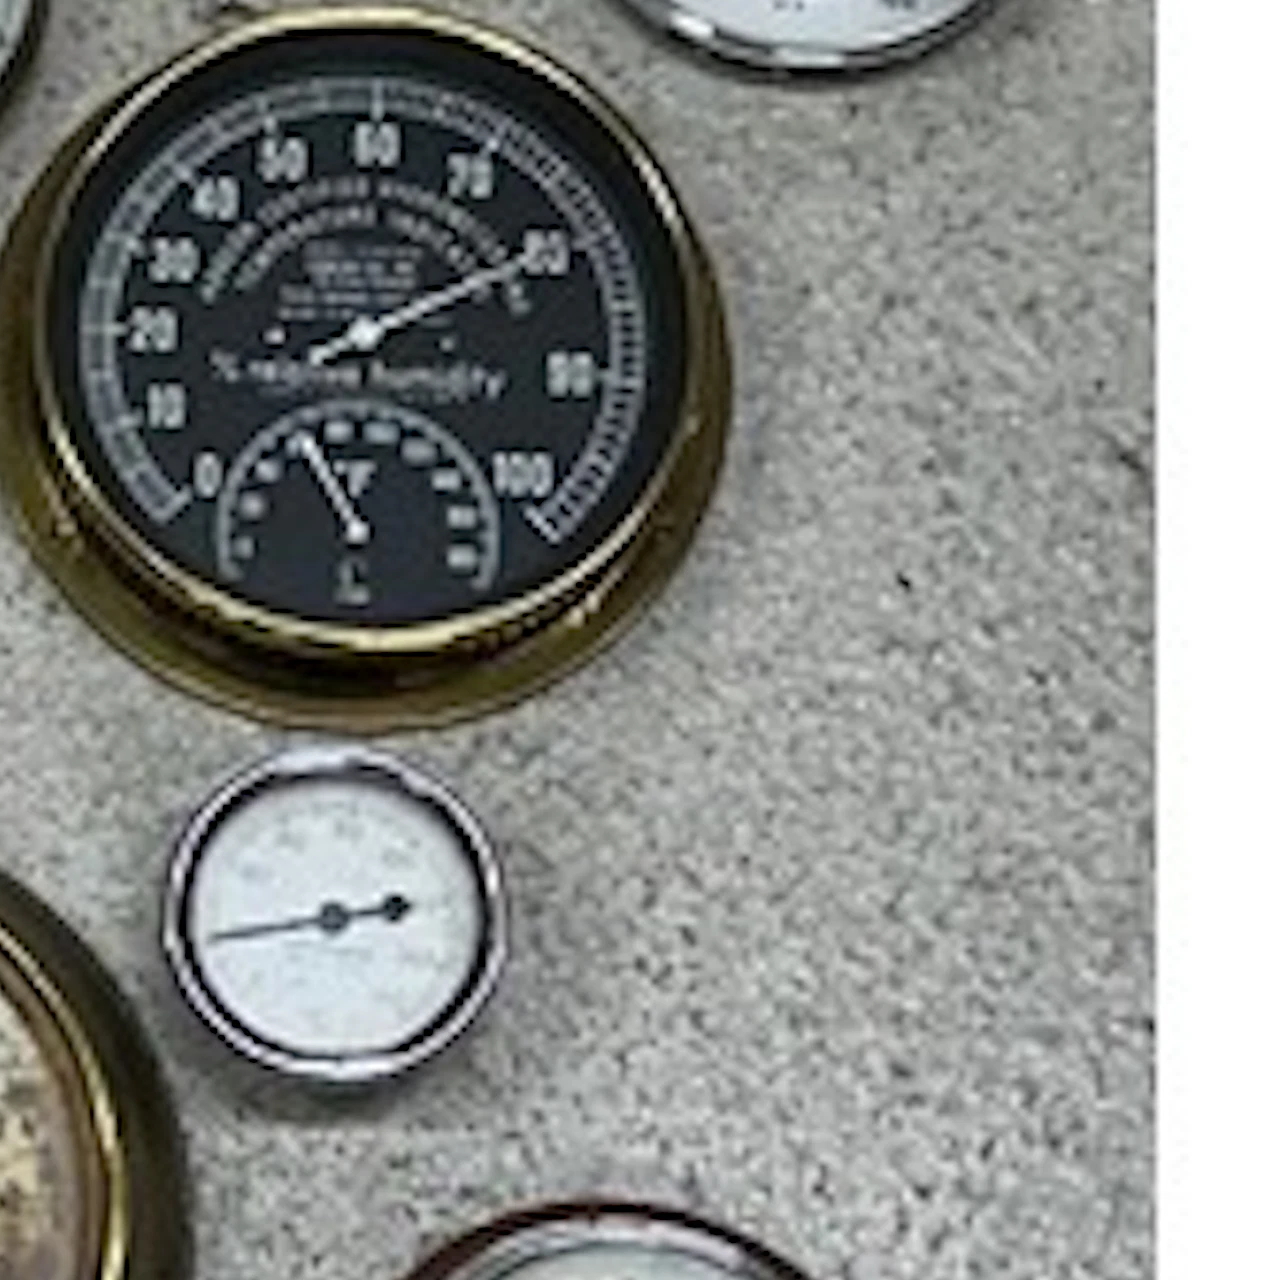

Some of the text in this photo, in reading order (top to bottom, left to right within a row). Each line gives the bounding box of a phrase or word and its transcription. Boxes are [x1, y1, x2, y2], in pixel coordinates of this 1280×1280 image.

[258, 136, 310, 183] 50
[353, 121, 402, 169] 60
[192, 174, 240, 221] 40
[447, 150, 495, 201] 70
[146, 236, 200, 283] 30
[520, 229, 571, 276] 80
[127, 305, 179, 354] 20
[545, 350, 596, 399] 90
[146, 382, 187, 430] 10
[192, 449, 224, 499] 0
[493, 450, 557, 498] 100
